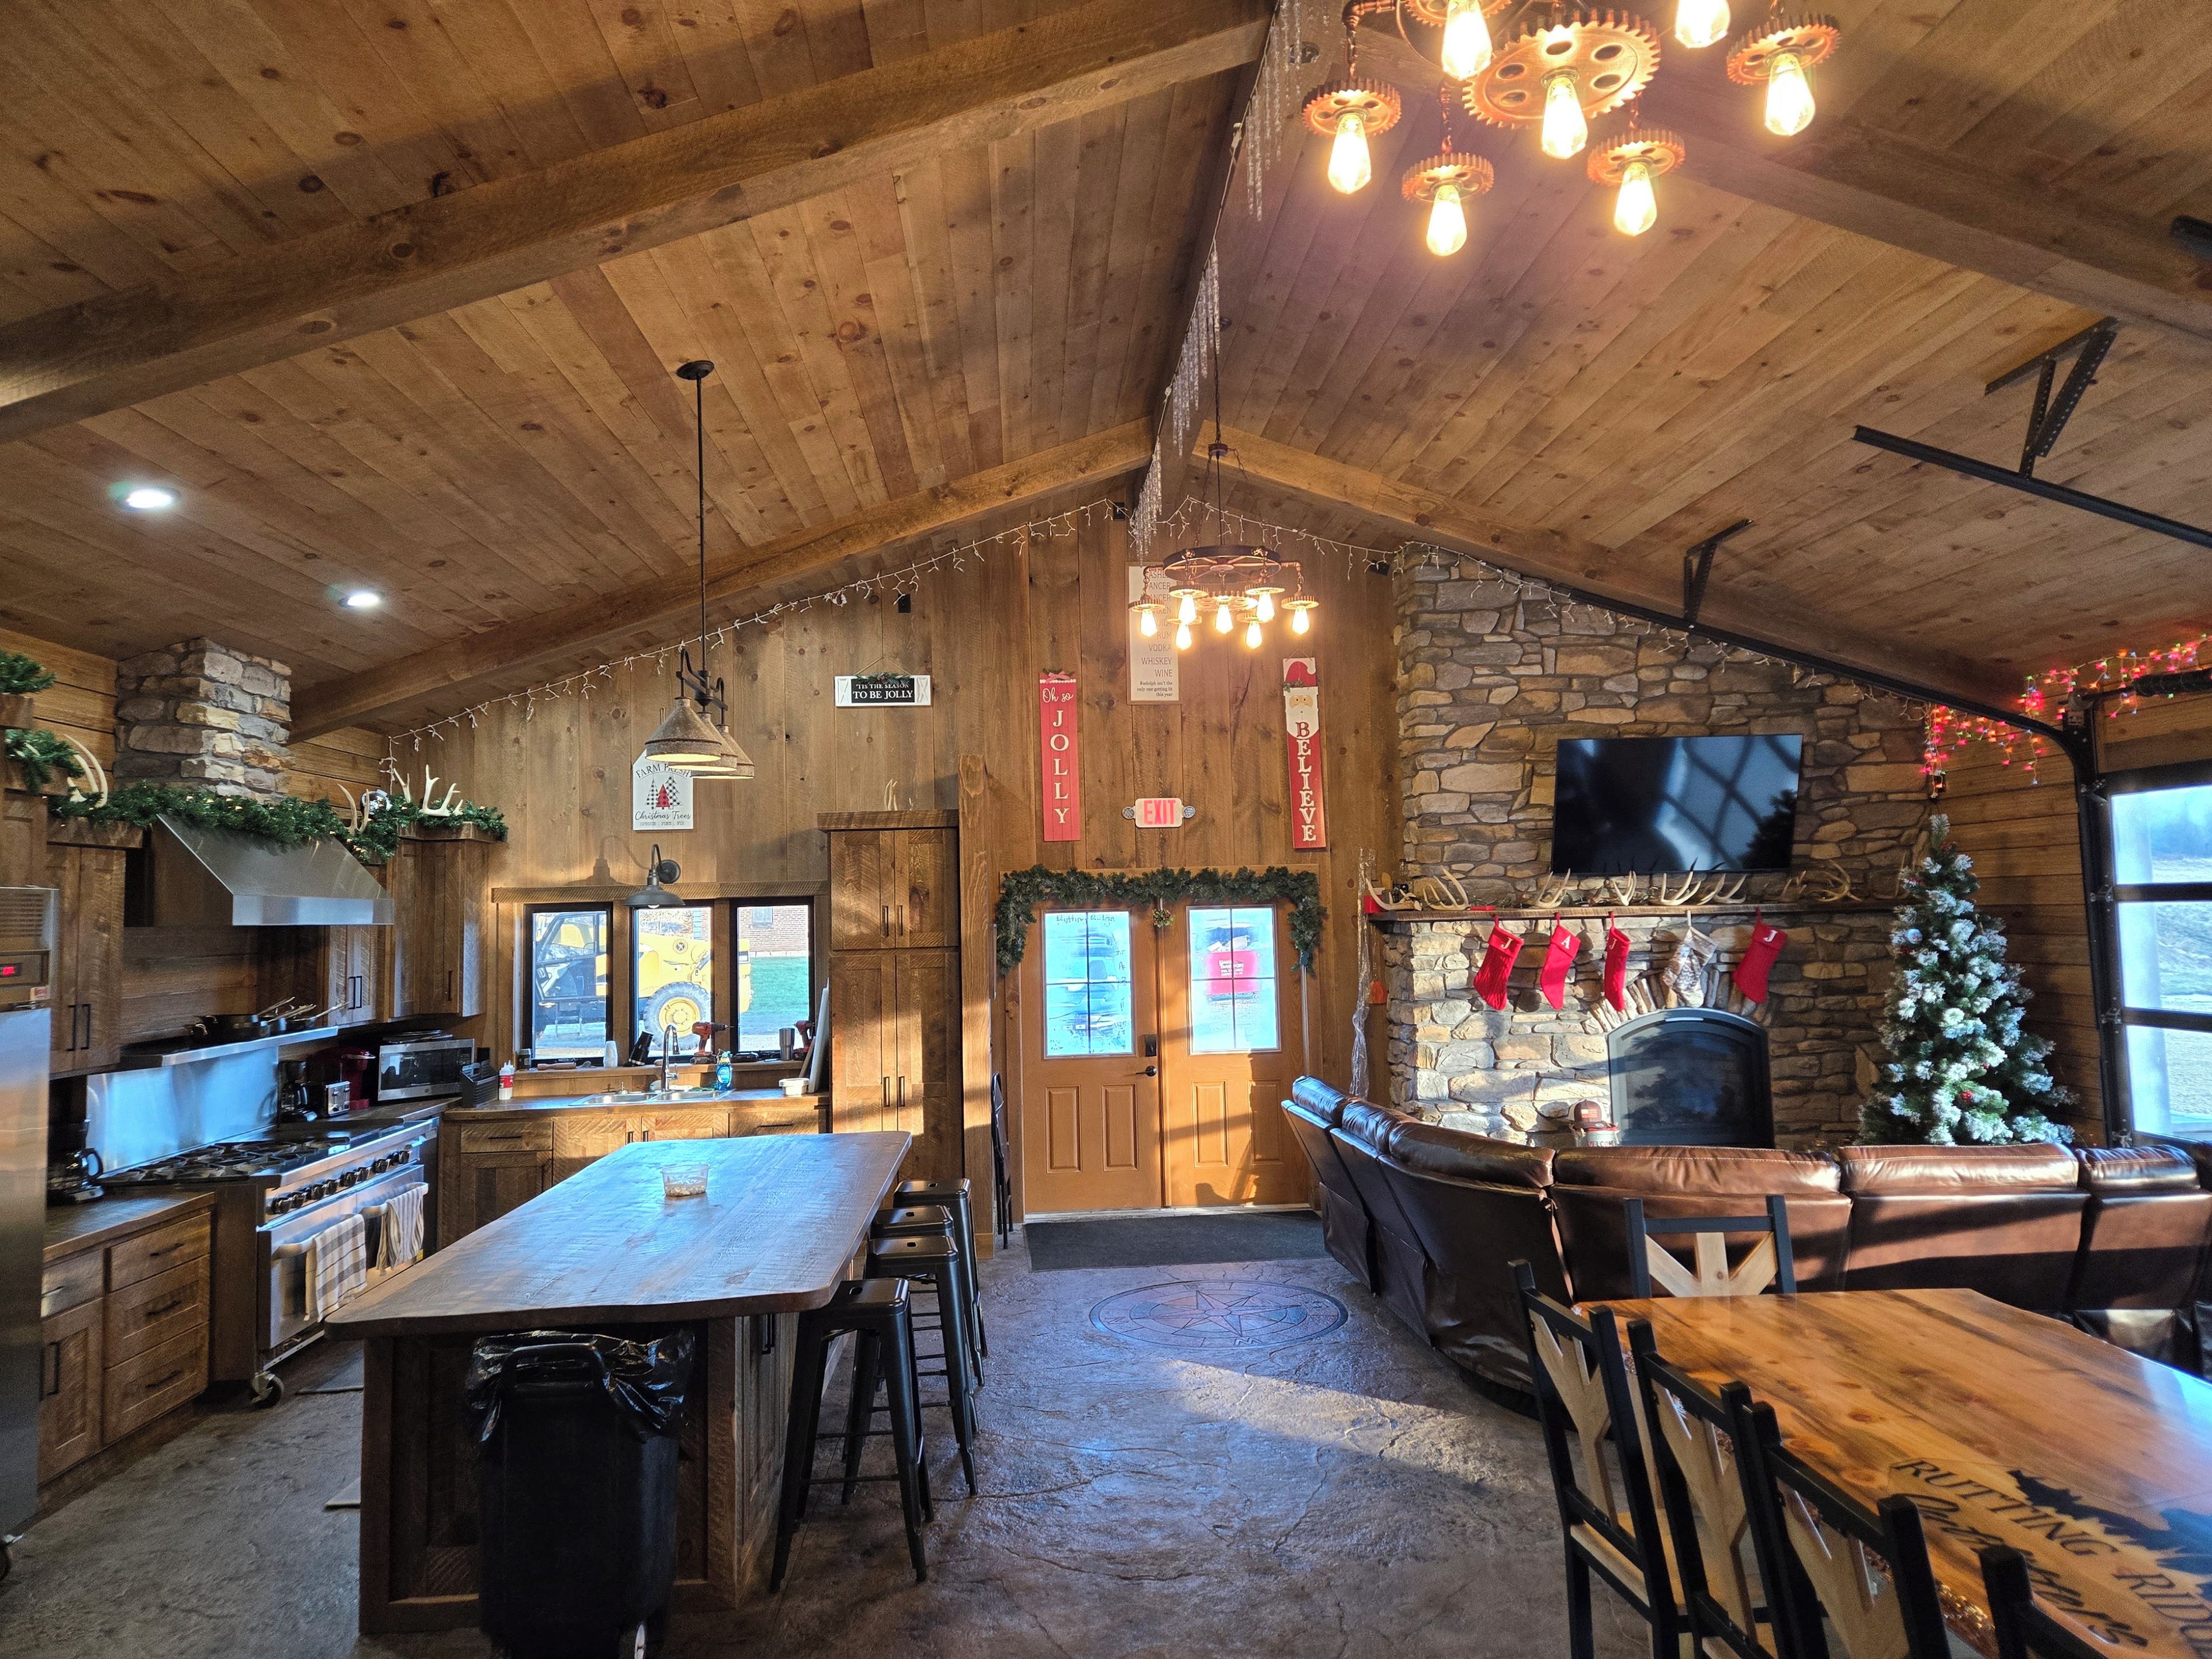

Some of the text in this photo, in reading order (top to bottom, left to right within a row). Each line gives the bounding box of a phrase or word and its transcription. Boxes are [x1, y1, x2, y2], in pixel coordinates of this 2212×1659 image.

[853, 690, 913, 699] TO BE JOLLY
[1042, 688, 1074, 703] Oh so
[635, 763, 661, 778] FARM
[1050, 710, 1070, 824] JOLLY
[1295, 721, 1317, 842] BELIEVE
[635, 810, 691, 820] Christmas Trees
[1143, 800, 1176, 825] EXIT
[1560, 934, 1571, 949] A
[1763, 929, 1778, 942] J
[1500, 937, 1513, 950] J
[1609, 938, 1617, 950] J
[1891, 1460, 2119, 1555] RUTTING
